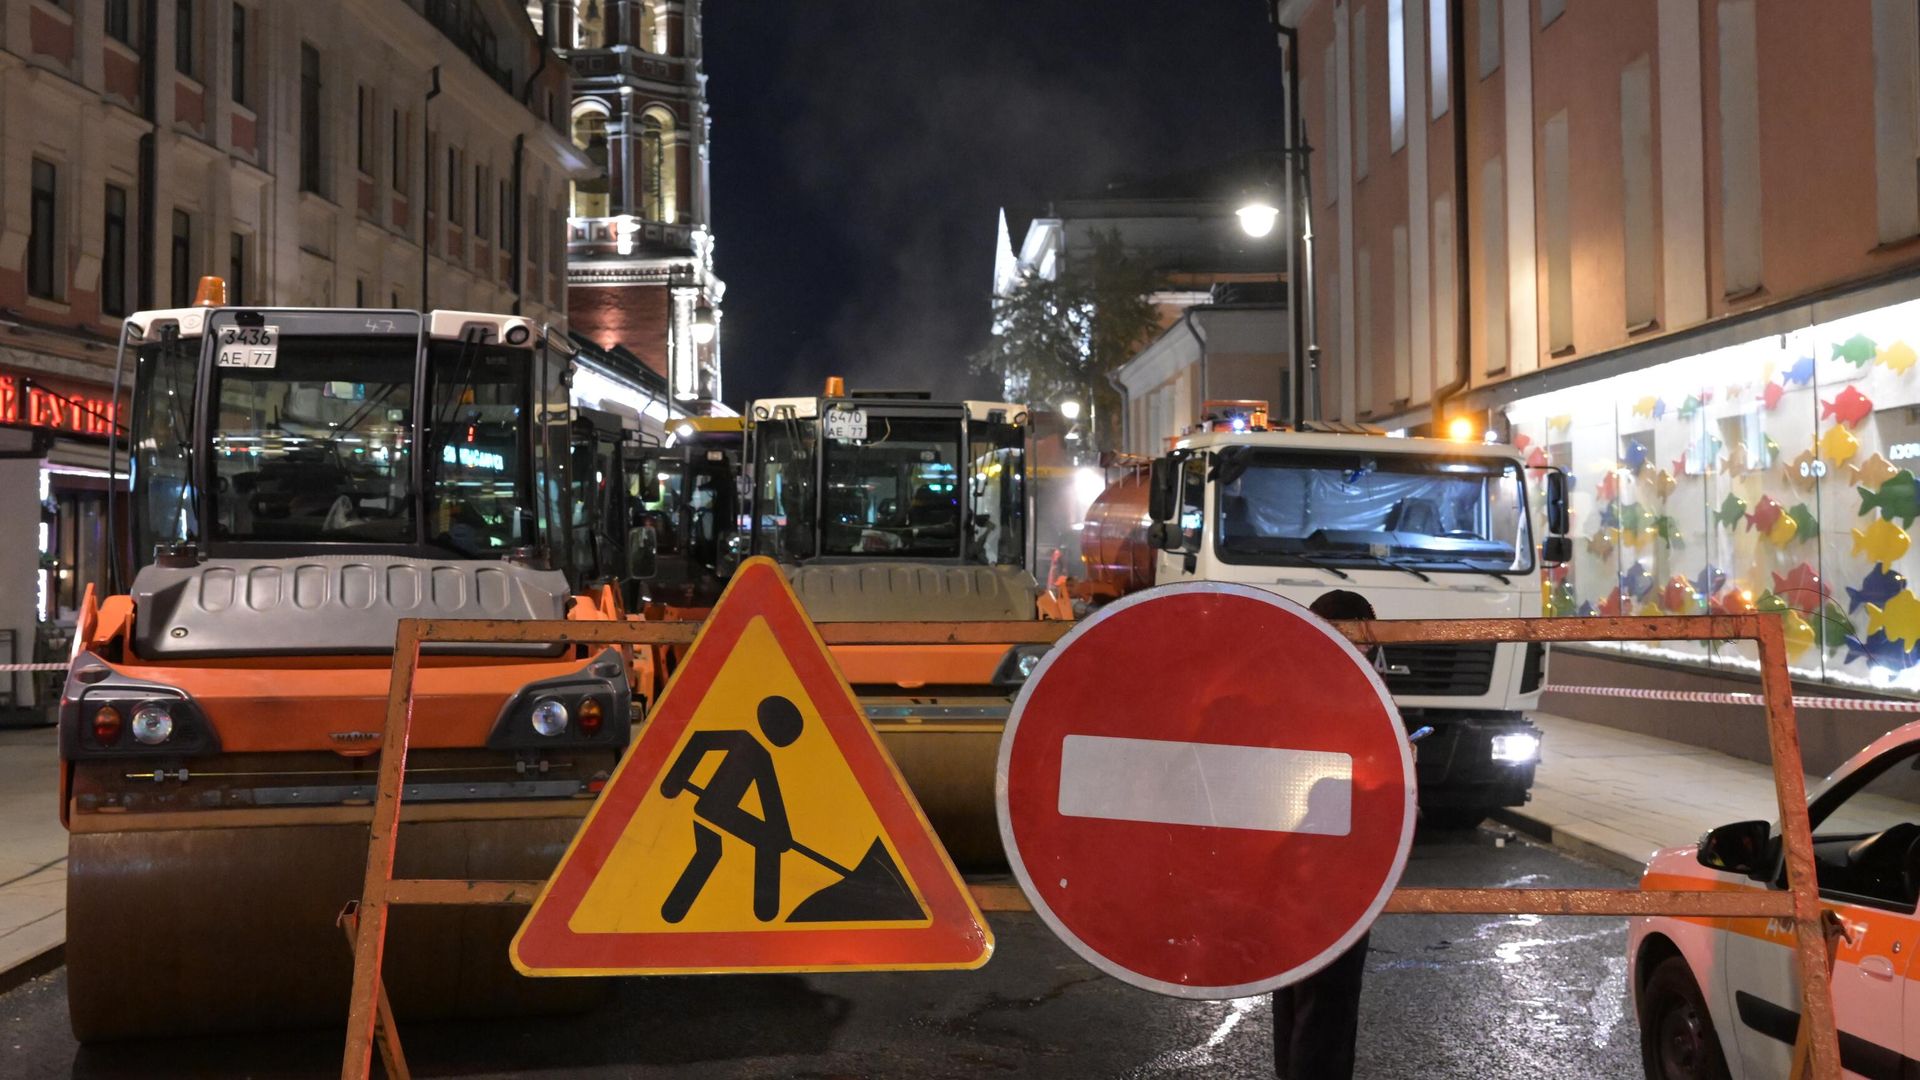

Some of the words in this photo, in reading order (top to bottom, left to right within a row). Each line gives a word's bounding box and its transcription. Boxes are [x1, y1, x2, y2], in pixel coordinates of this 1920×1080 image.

[365, 319, 396, 333] 47
[224, 329, 272, 346] 3436
[254, 353, 272, 366] 77
[851, 427, 864, 437] 77
